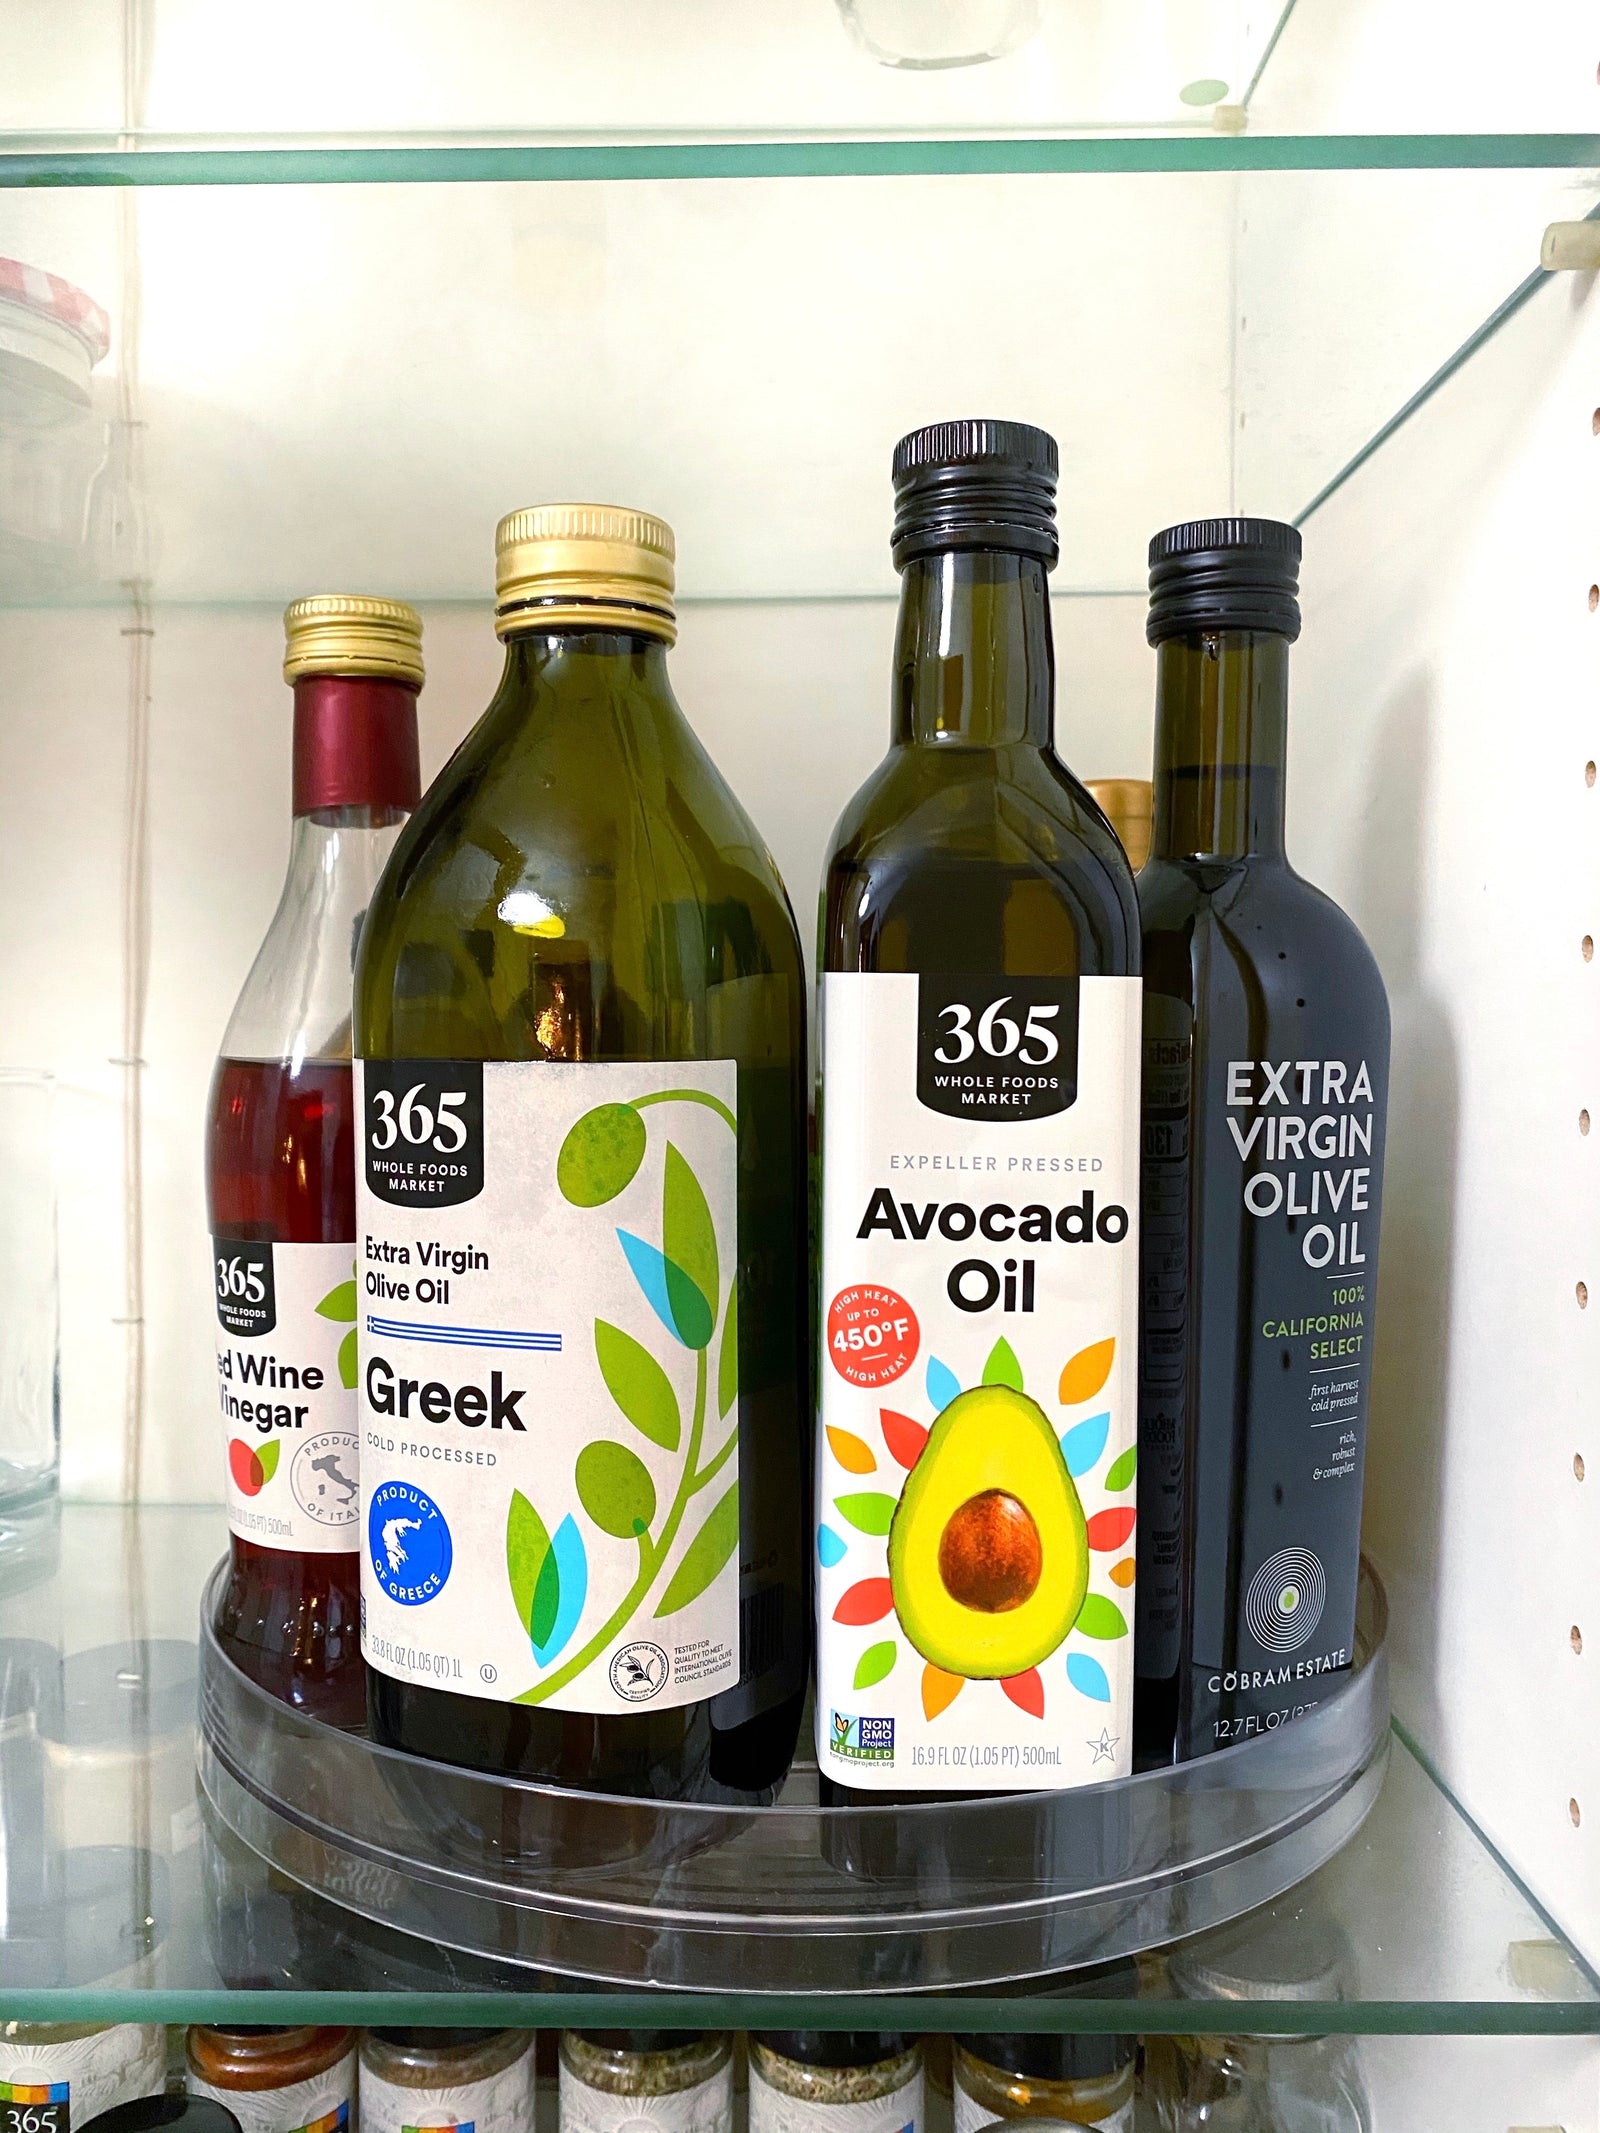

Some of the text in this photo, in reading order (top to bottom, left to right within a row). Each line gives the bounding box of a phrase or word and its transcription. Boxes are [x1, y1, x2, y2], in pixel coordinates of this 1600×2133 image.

[934, 996, 1060, 1065] 365
[934, 1075, 1059, 1089] WHOLE FOODS
[1226, 1060, 1374, 1106] EXTRA
[961, 1093, 1032, 1105] MARKET
[372, 1083, 468, 1154] 365
[1226, 1113, 1373, 1162] VIRGIN
[373, 1160, 468, 1177] WHOLE FOODS
[890, 1155, 1103, 1172] EXPELLER PRESSED
[389, 1178, 445, 1193] MARKET
[1244, 1167, 1370, 1217] OLIVE
[856, 1187, 1129, 1244] Avocado
[366, 1235, 489, 1275] Extra Virgin
[1302, 1221, 1366, 1269] OIL
[217, 1256, 265, 1303] 365
[366, 1271, 449, 1305] Olive Oil
[947, 1258, 1035, 1313] Oil
[834, 1290, 898, 1313] HIGH HEAT
[1332, 1285, 1365, 1306] 100%
[219, 1303, 266, 1318] WHOLE FOODS
[226, 1316, 253, 1327] MARKET
[847, 1308, 879, 1321] UP TO
[833, 1317, 909, 1352] 450°F
[1262, 1311, 1364, 1339] CALIFORNIA
[1310, 1335, 1363, 1360] SELECT
[218, 1349, 324, 1390] ed Wine
[845, 1352, 907, 1382] HIGH HEAT
[366, 1356, 528, 1432] Greek
[1308, 1378, 1359, 1400] first harvest
[1311, 1392, 1358, 1413] cold pressed
[304, 1437, 359, 1456] PRODUC
[367, 1432, 497, 1466] COLD PROCESSED
[1332, 1446, 1355, 1462] robust
[1323, 1460, 1355, 1480] complex
[307, 1503, 360, 1521] OF ITA
[376, 1486, 438, 1520] PRODUCT
[268, 1518, 294, 1537] 500mL
[375, 1559, 441, 1601] OF GREECE
[386, 1642, 394, 1662] FL
[395, 1646, 406, 1666] OZ
[407, 1648, 431, 1671] (1.05
[433, 1655, 449, 1678] QT)
[453, 1658, 463, 1678] 1L
[674, 1640, 710, 1655] TESTED FOR
[674, 1652, 701, 1665] QUALITY
[711, 1644, 724, 1655] MEET
[674, 1649, 732, 1674] INTERNATIONAL OLIVE
[674, 1671, 703, 1684] COUNCIL
[703, 1659, 731, 1677] STANDARDS
[1296, 1648, 1346, 1680] ESTATE
[861, 1730, 892, 1739] GMO
[862, 1720, 891, 1730] NON
[832, 1741, 891, 1759] VERIFIED
[861, 1739, 892, 1749] Project
[911, 1745, 1062, 1768] 16.9 FL OZ (1.05 PT) 500mL
[6, 2105, 58, 2133] 365
